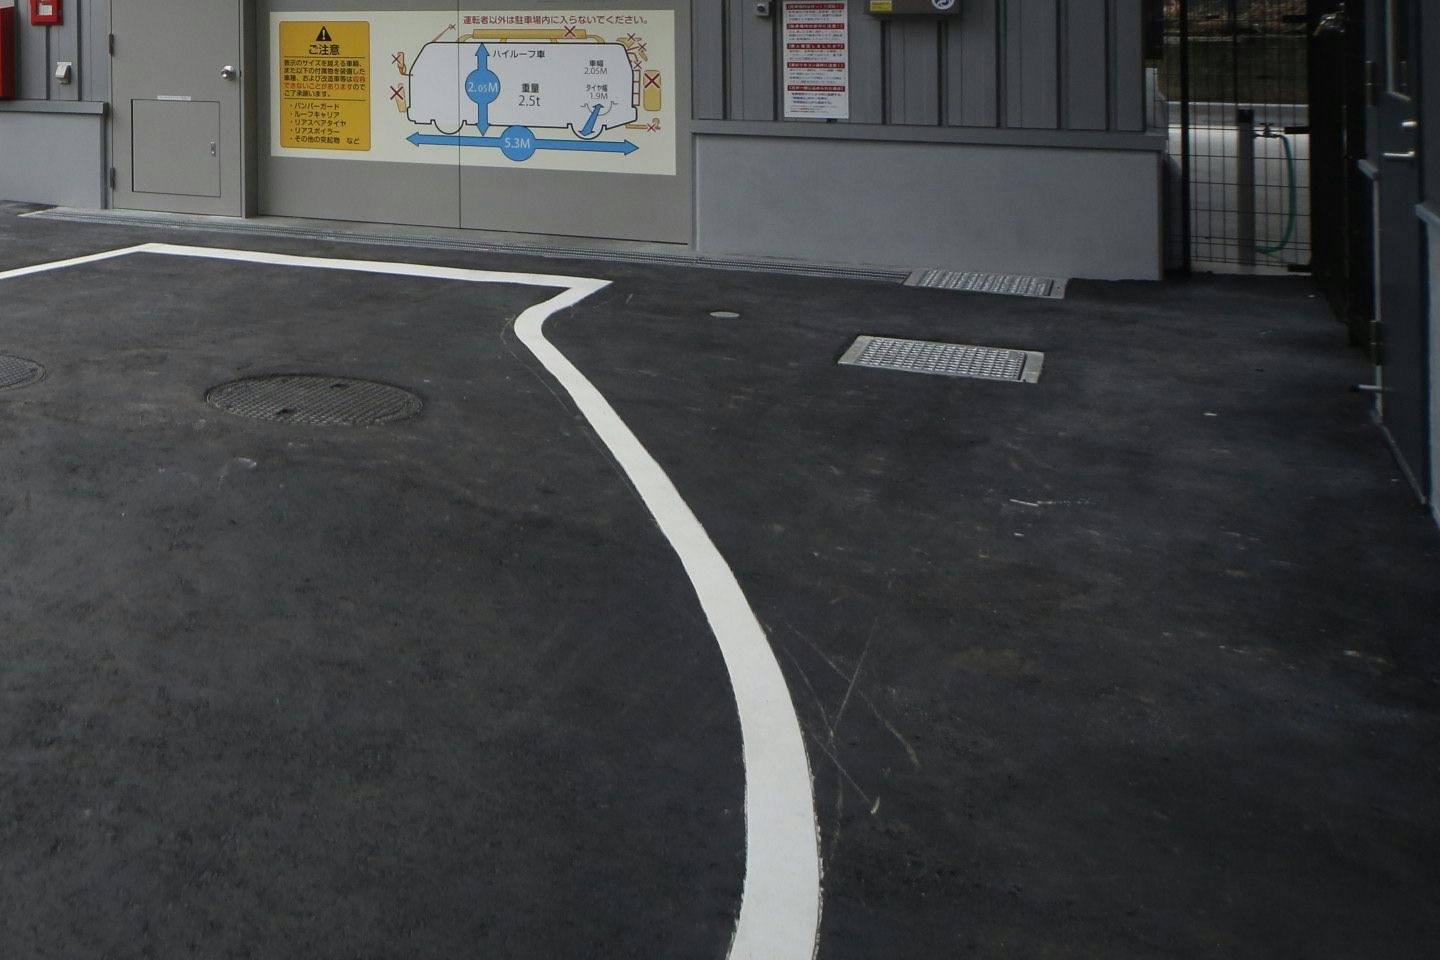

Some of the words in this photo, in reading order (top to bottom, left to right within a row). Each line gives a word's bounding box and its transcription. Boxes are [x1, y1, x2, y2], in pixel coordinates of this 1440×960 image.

[463, 15, 648, 25] 運転者以外は駐車場内に入らないでください。
[309, 44, 340, 55] ご注意
[492, 50, 546, 58] ハイルーフ車
[584, 67, 608, 75] 2.05M
[467, 82, 500, 93] 2.05M
[521, 83, 540, 93] 重量
[518, 95, 541, 107] 2.5t
[589, 92, 608, 100] 1.9M
[504, 137, 531, 149] 5.3M
